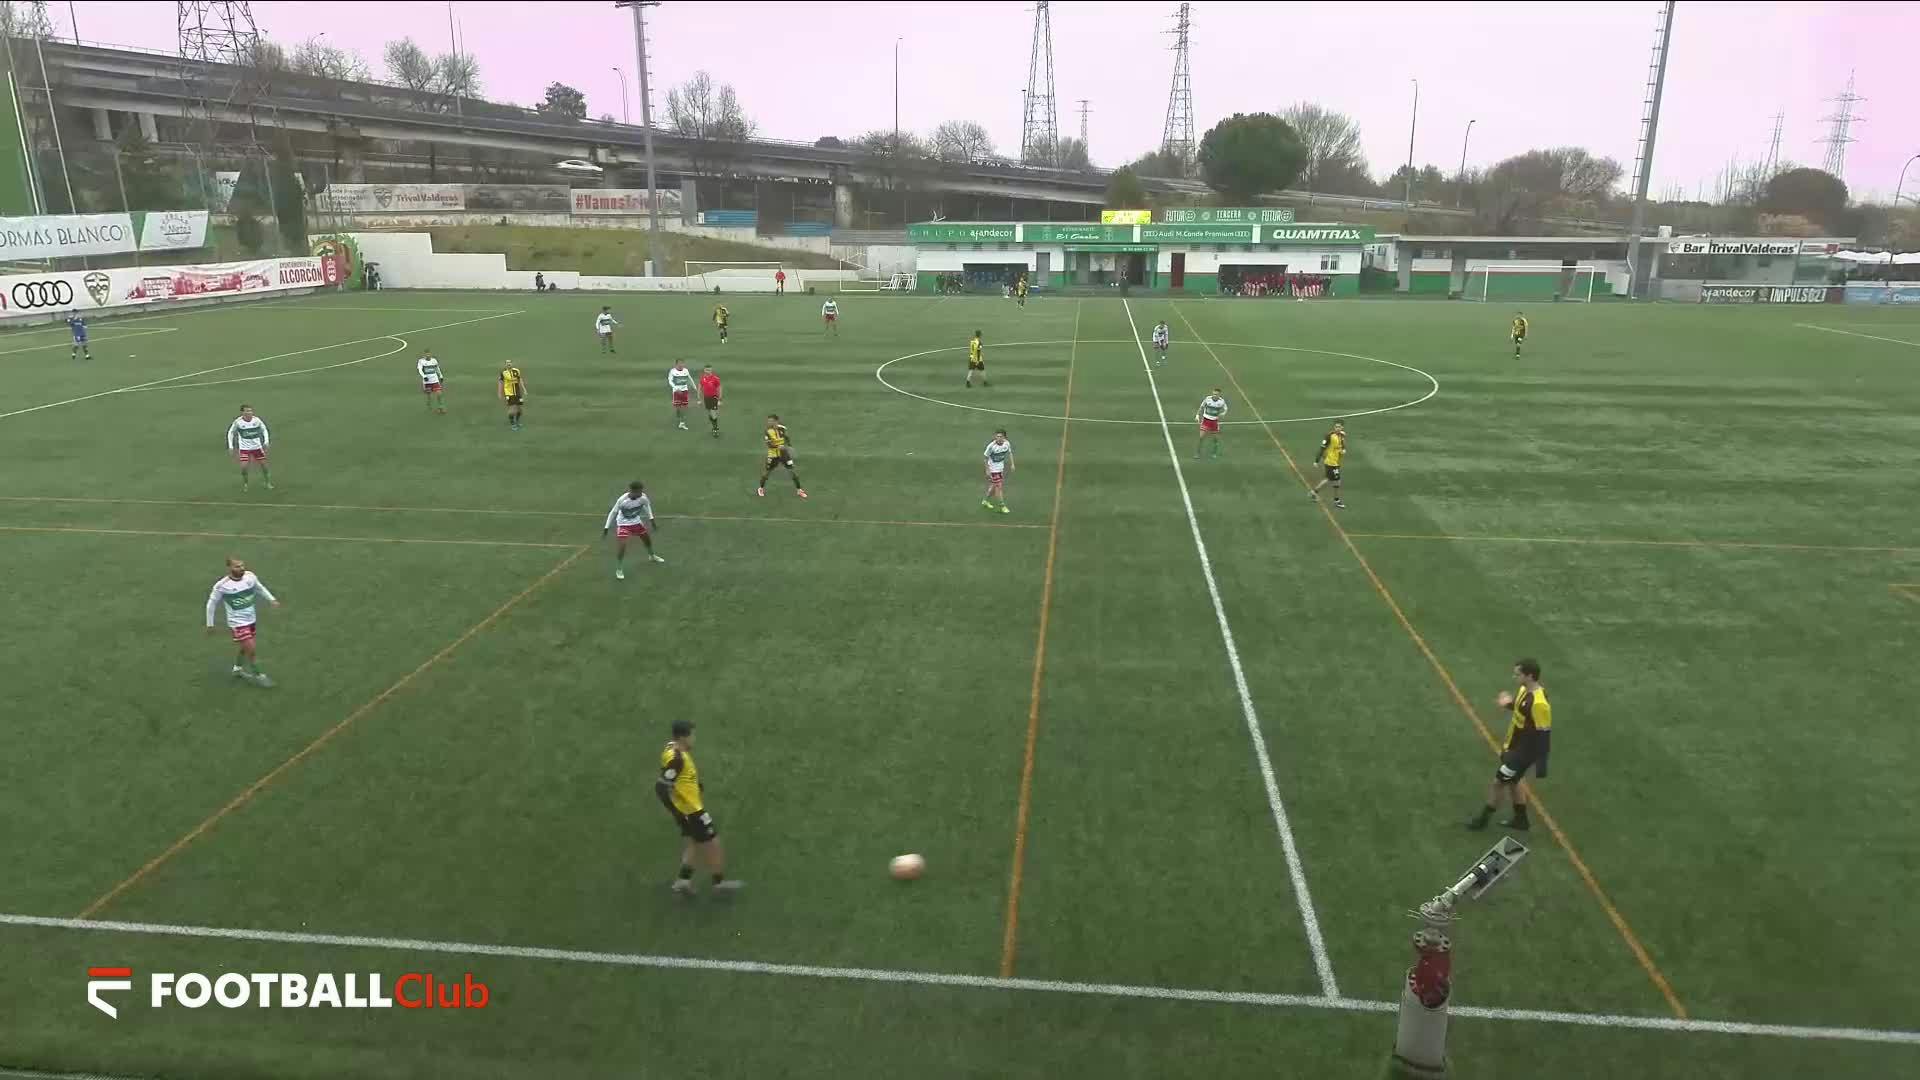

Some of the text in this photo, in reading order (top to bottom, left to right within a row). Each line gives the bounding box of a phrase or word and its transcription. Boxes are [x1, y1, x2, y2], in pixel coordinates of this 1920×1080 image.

[57, 224, 123, 245] BLANCO
[970, 228, 1013, 240] afandecor
[1273, 229, 1361, 239] QUAMTRAX
[1684, 243, 1705, 253] Bar
[1712, 243, 1795, 254] TrivalValderas
[280, 264, 323, 284] ALCORCÓN
